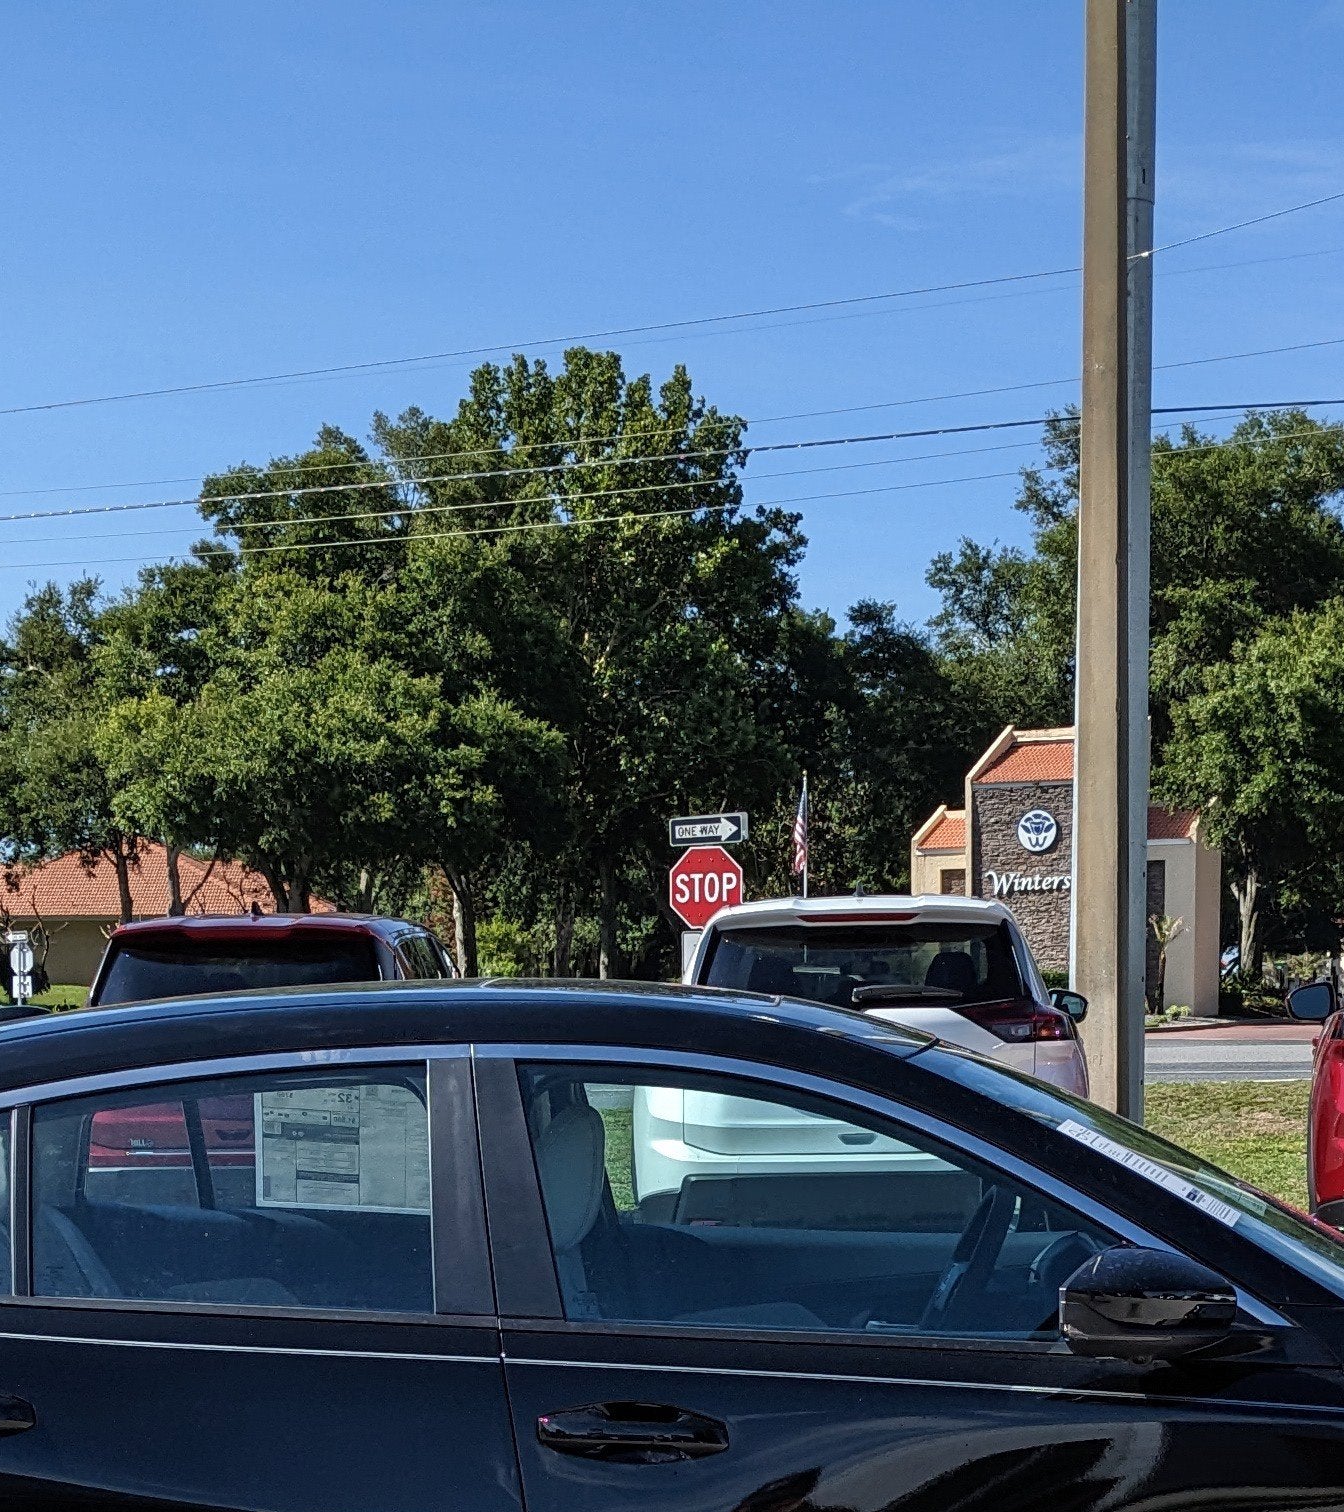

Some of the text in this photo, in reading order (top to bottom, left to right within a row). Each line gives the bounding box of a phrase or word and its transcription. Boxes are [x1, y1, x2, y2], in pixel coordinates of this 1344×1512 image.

[678, 824, 720, 837] ONE WAY
[675, 872, 737, 903] STOP
[984, 870, 1071, 895] Winters
